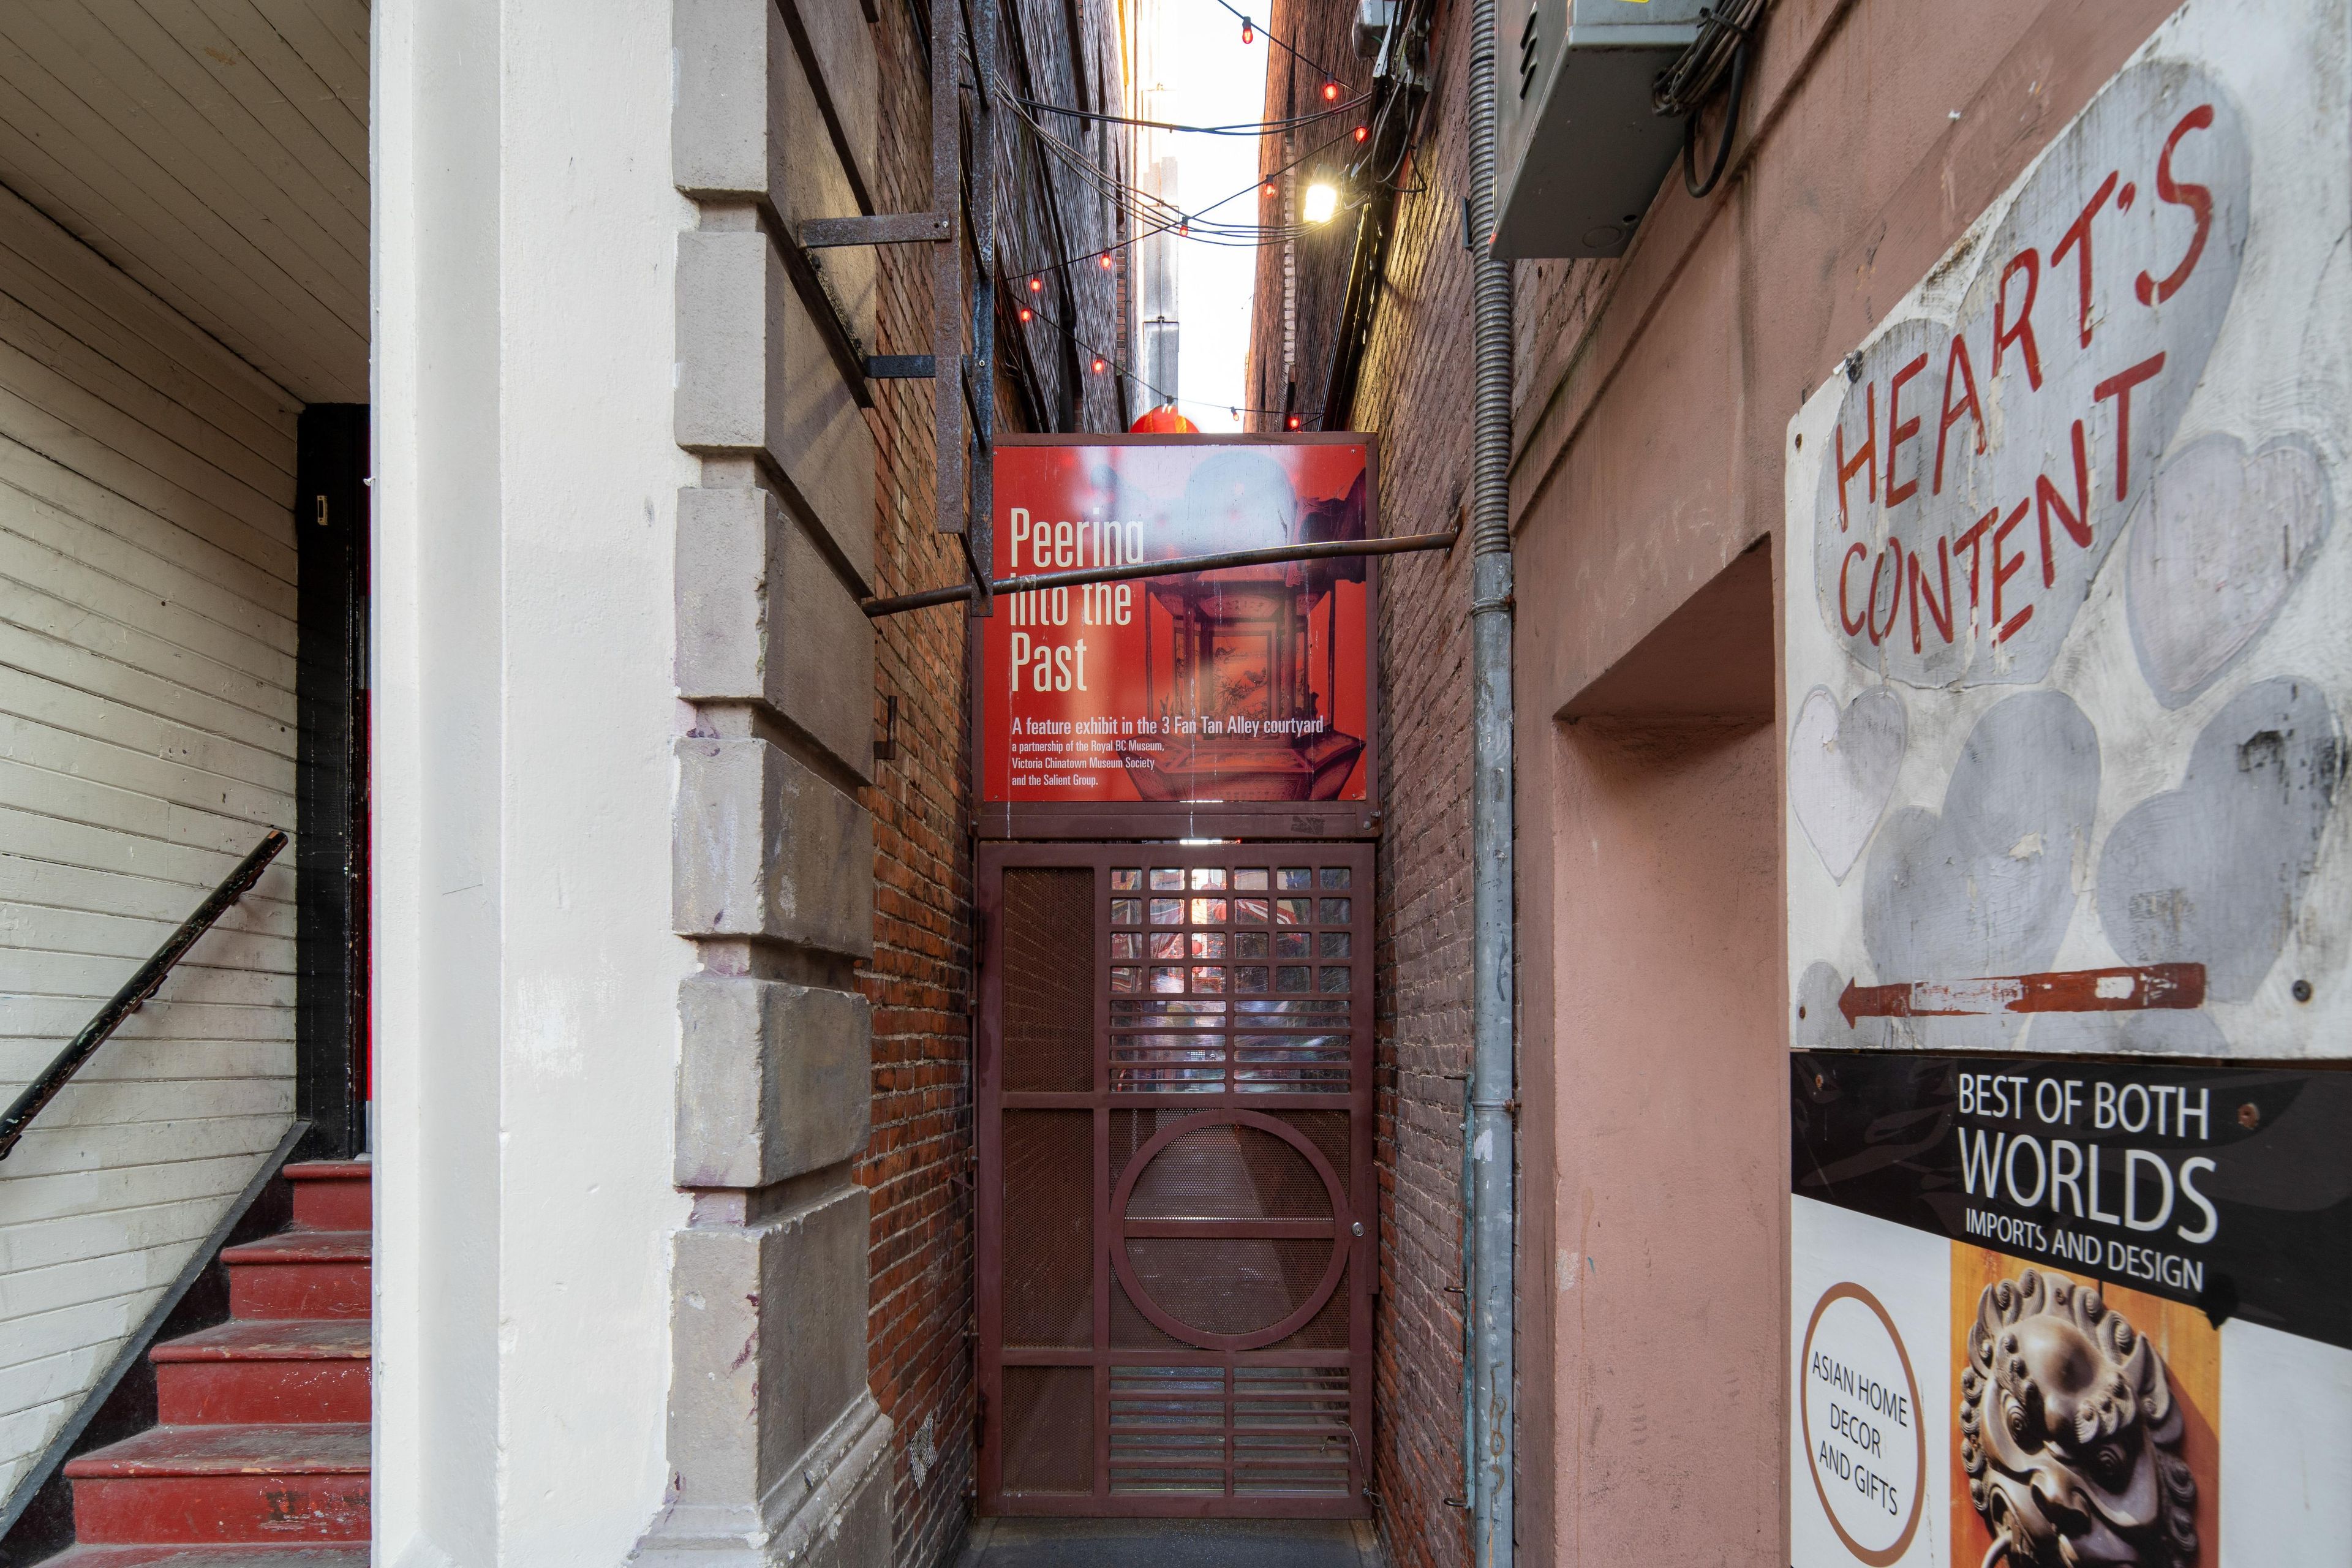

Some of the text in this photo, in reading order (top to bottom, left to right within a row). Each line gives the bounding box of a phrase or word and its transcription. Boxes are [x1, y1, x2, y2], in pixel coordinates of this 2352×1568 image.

[1836, 104, 2215, 533] HEART'S
[1839, 351, 2166, 655] CONTENT
[1011, 507, 1144, 568] Peering
[1010, 573, 1131, 626] into the
[1011, 632, 1087, 692] Past
[1012, 715, 1324, 737] A feature exhibit in the 3 Fan Tan Alley courtyard
[1012, 740, 1164, 754] a partnership of the Royal BC Museum,
[1012, 756, 1155, 771] Victoria Chinatown Museum Society
[1012, 774, 1098, 788] and the Salient Group.
[1959, 1073, 2209, 1140] BEST OF BOTH
[1958, 1126, 2218, 1245] WORLDS
[1966, 1207, 2204, 1293] IMPORTS AND DESIGN
[1812, 1351, 1907, 1428] ASIAN HOME
[1830, 1402, 1882, 1459] DECOR
[1819, 1439, 1898, 1517] AND GIFTS
